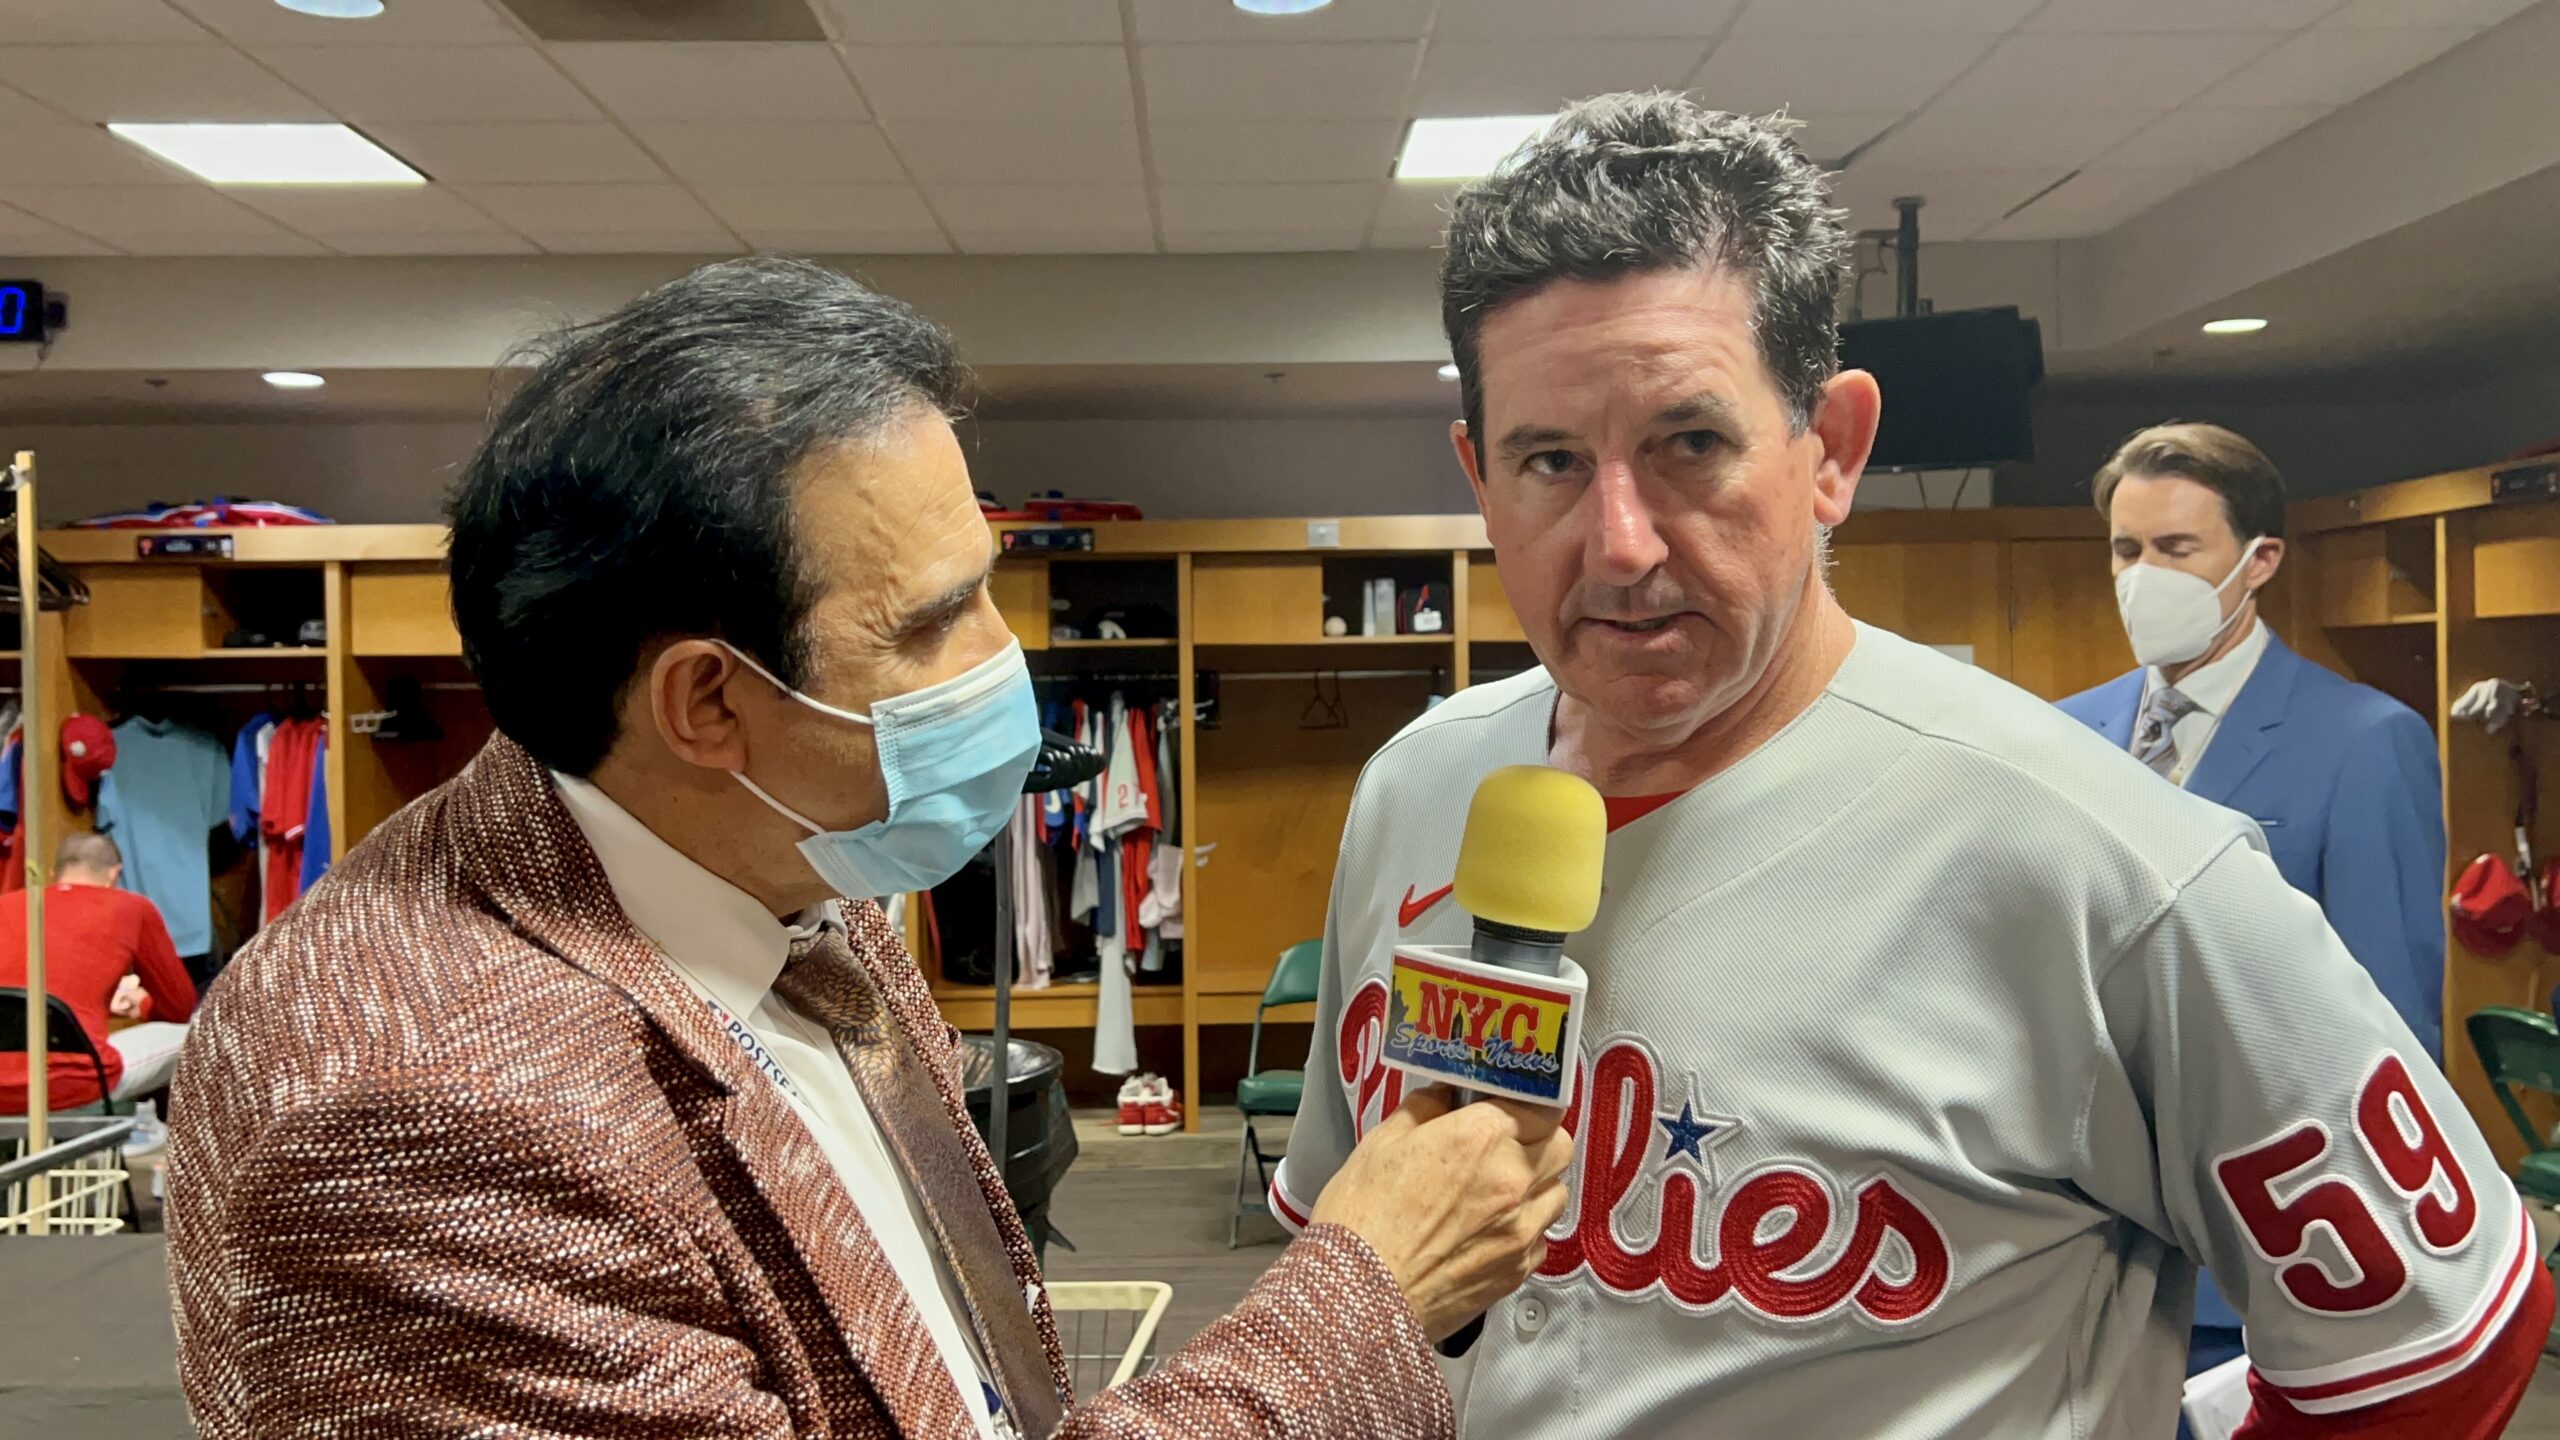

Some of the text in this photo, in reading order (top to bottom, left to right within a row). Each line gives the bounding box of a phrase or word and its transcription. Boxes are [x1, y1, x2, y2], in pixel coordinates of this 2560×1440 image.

[1389, 1022, 1560, 1074] Sports News
[1414, 980, 1541, 1054] NYC
[1337, 977, 1953, 1325] Plies
[2211, 1048, 2480, 1317] 59
